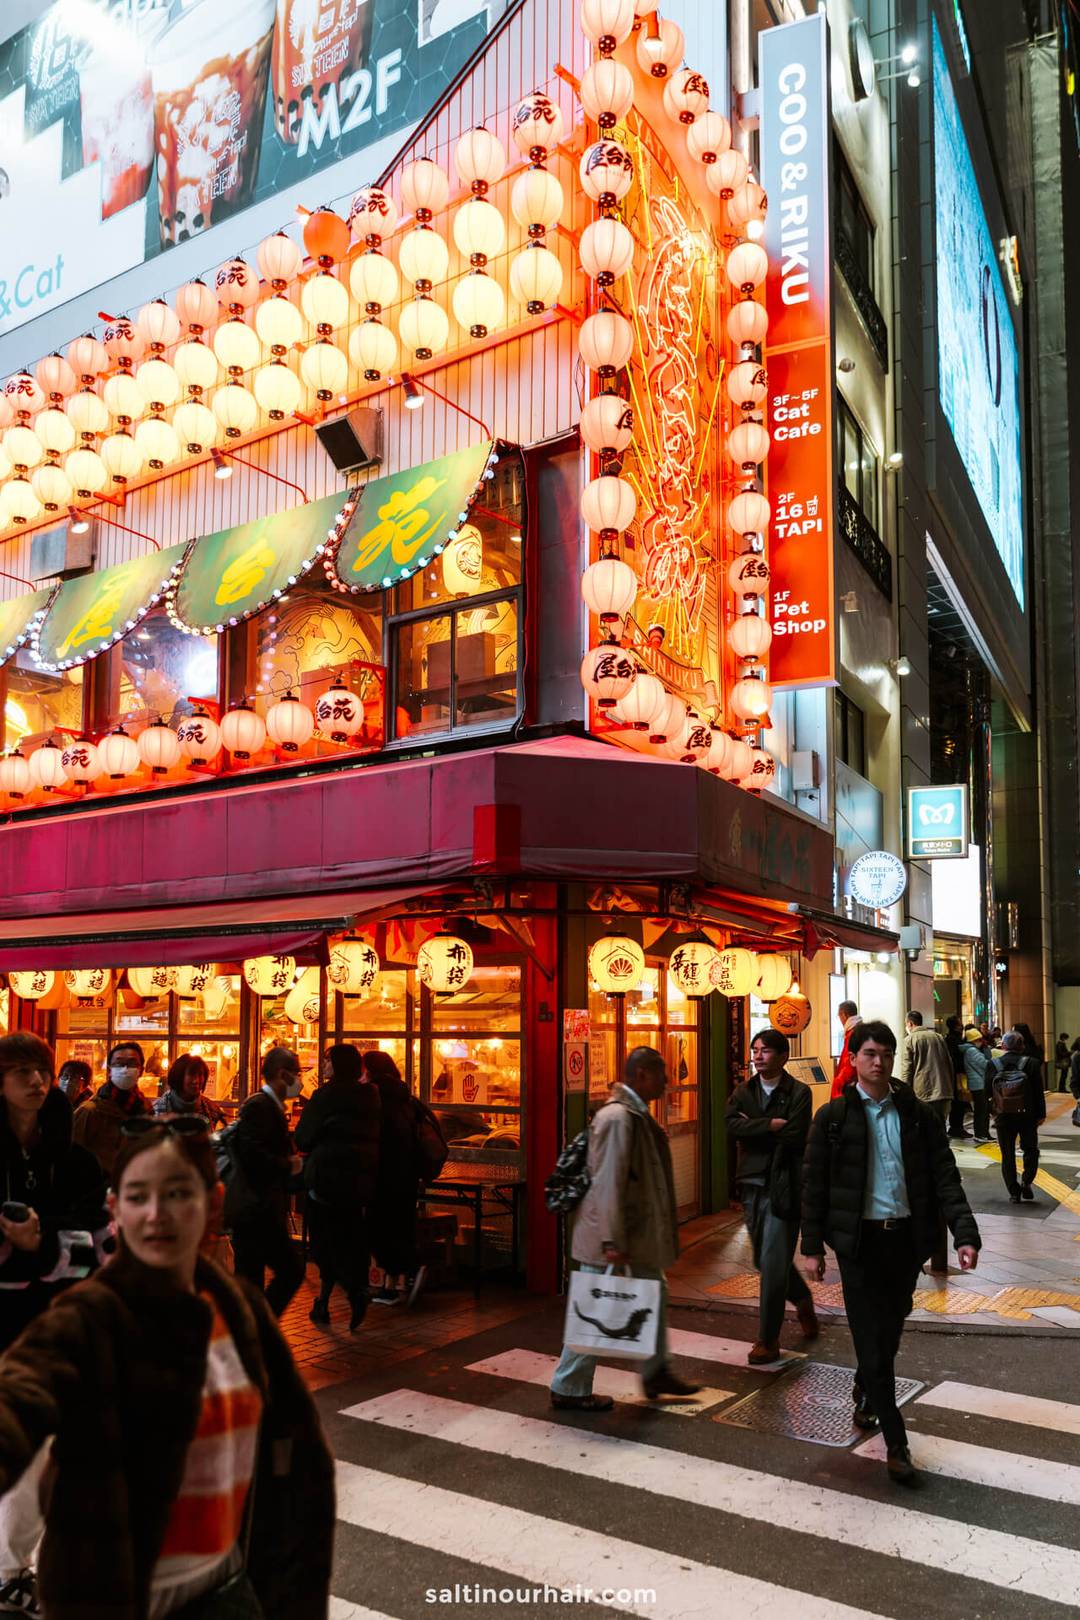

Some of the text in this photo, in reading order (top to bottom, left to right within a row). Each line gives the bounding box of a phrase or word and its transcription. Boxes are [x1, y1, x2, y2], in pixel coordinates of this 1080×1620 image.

[297, 48, 402, 158] M2F
[779, 63, 809, 306] COO & RIKU
[773, 403, 810, 422] Cat
[773, 422, 821, 441] Cafe
[778, 493, 796, 504] 2F
[775, 503, 803, 521] 16
[775, 518, 823, 539] TAPI
[773, 591, 791, 602] 1F
[773, 601, 810, 618] Pet
[773, 619, 826, 636] Shop
